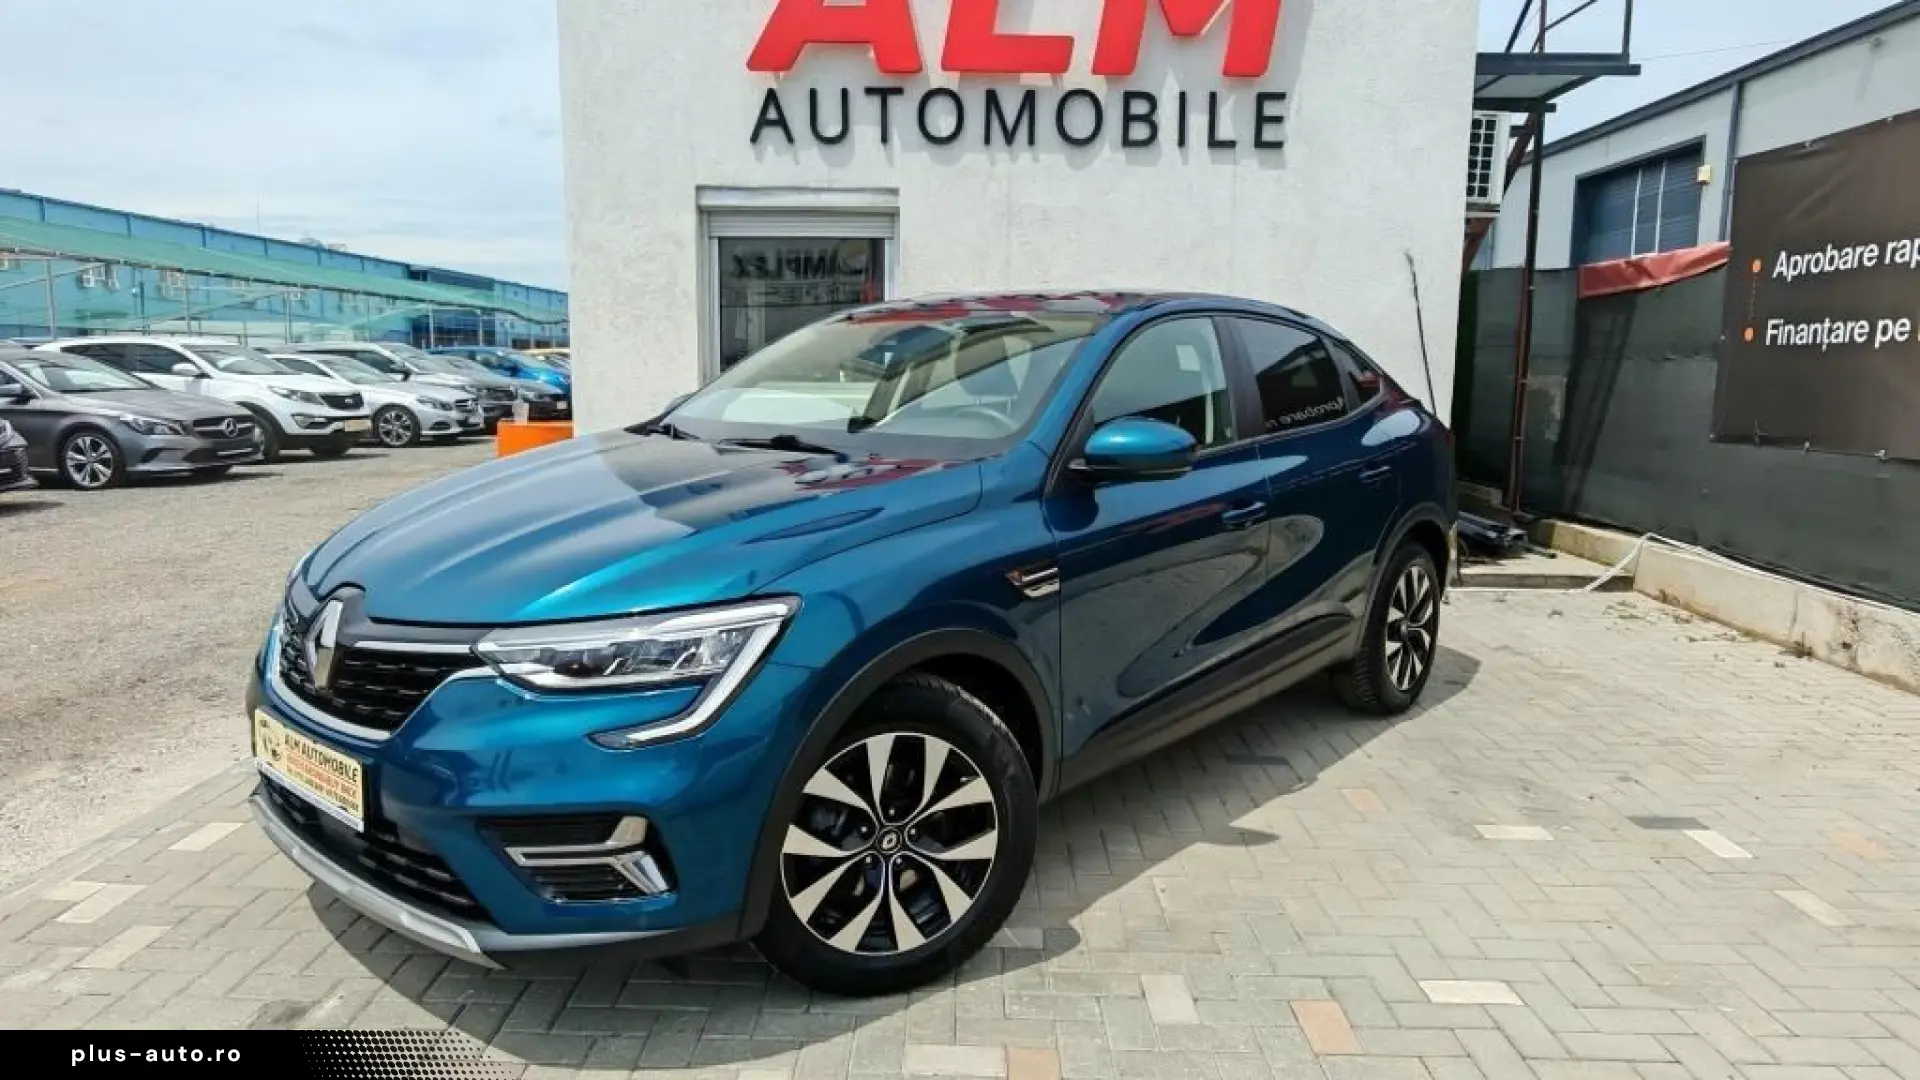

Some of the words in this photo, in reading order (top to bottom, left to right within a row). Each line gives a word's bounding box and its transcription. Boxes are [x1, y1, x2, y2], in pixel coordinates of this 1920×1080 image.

[746, 0, 1282, 77] ALM
[750, 87, 1287, 149] AUTOMOBILE
[1772, 243, 1880, 282] Aprobare
[1766, 316, 1870, 352] Finanțare
[1874, 316, 1912, 349] pe
[301, 743, 359, 783] AUTOMOBILE
